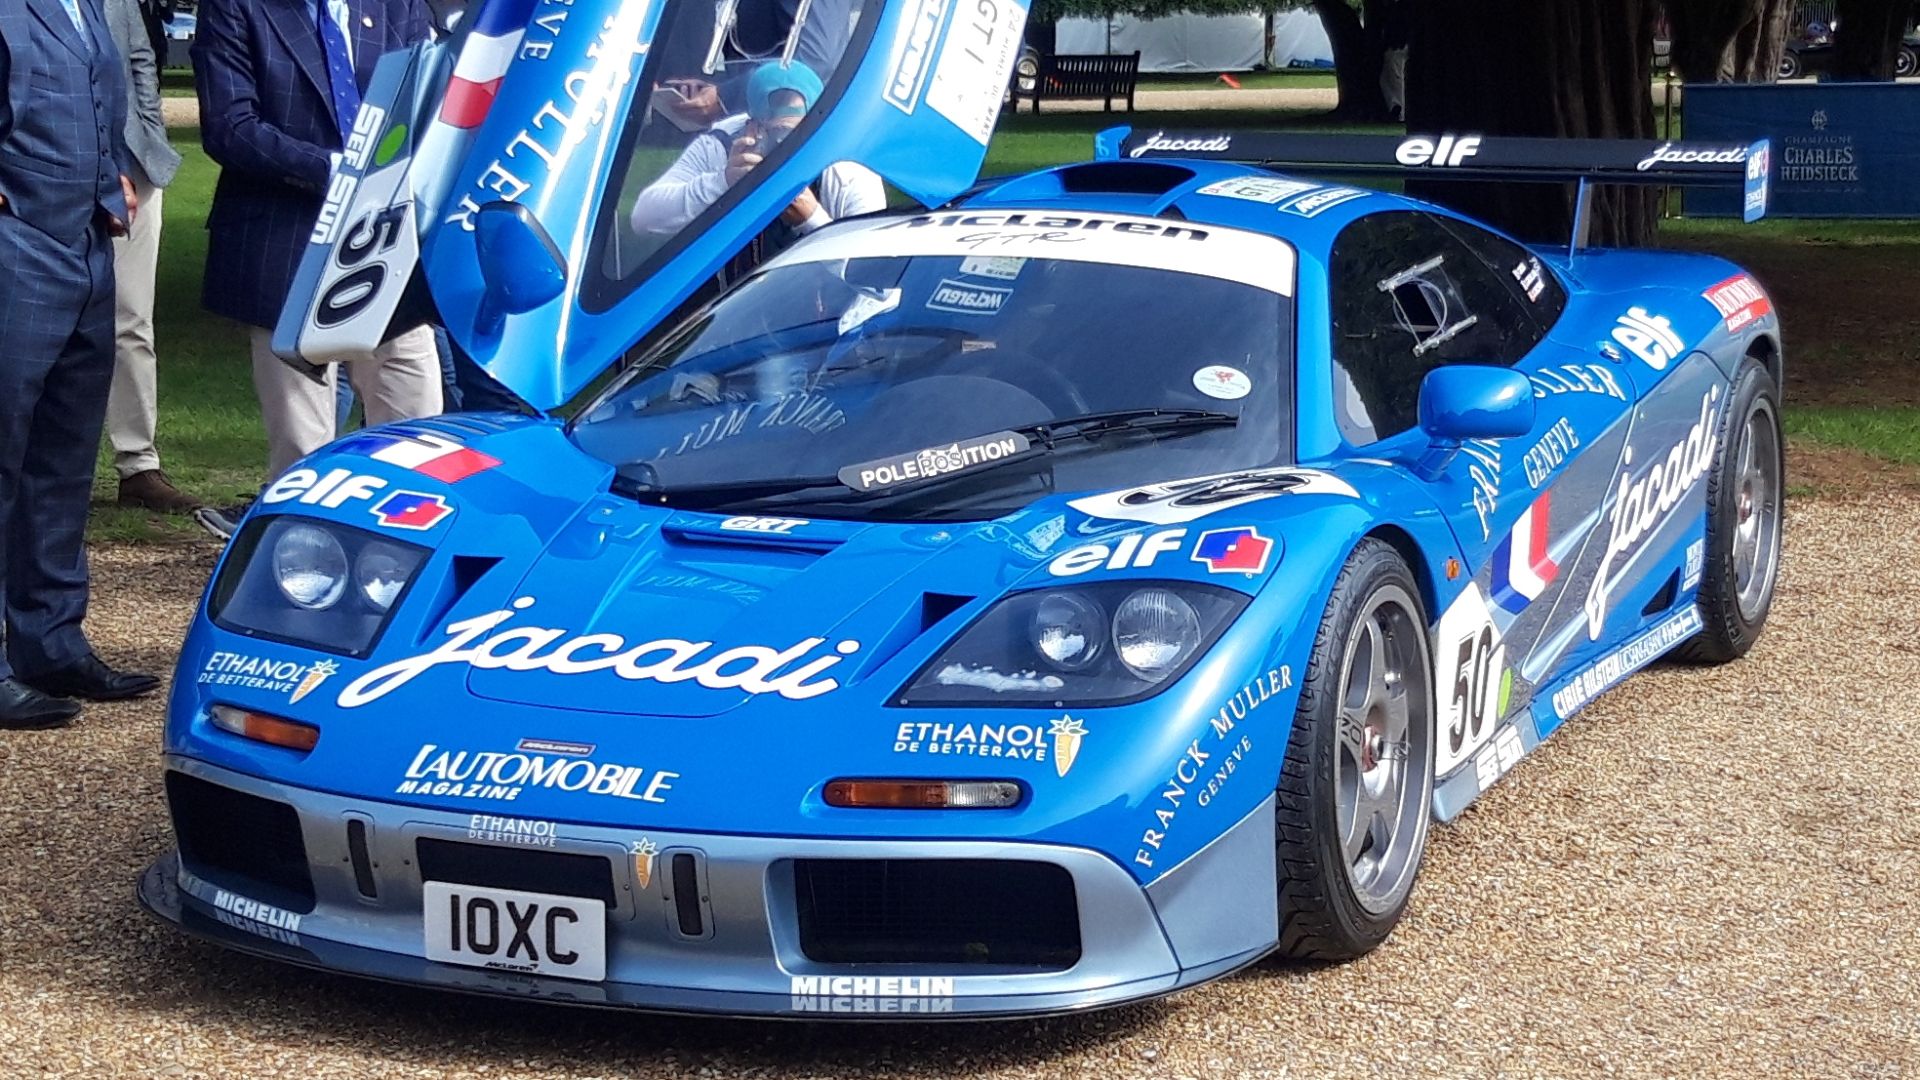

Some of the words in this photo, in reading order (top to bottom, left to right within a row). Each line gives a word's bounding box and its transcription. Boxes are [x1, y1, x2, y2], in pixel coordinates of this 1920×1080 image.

[1129, 130, 1232, 159] jacadi
[1395, 133, 1480, 167] elf
[1636, 142, 1748, 171] jacadi
[1784, 146, 1854, 164] CHARLES
[1780, 166, 1859, 181] HEIDSIECK
[873, 213, 1209, 242] McLaren
[314, 200, 413, 330] 50
[1611, 305, 1686, 371] elf
[1522, 416, 1580, 490] GENEVE
[262, 468, 388, 509] elf
[719, 516, 811, 535] GRT
[1585, 383, 1718, 641] jacadi
[1048, 528, 1188, 577] elf
[205, 651, 307, 683] ETHANOL
[337, 595, 861, 709] jacadi
[198, 672, 216, 683] DE
[217, 674, 295, 693] BETTERAVE
[1449, 620, 1494, 759] 50
[896, 722, 1048, 748] ETHANOL
[893, 741, 920, 753] DE
[928, 743, 1047, 762] BETTERAVE
[1135, 738, 1211, 869] FRANCK
[1210, 664, 1294, 740] MULLER
[1197, 734, 1253, 808] GENEVE
[395, 780, 522, 801] MAGAZINE
[468, 829, 484, 840] DE
[487, 831, 558, 848] BETTERAVE
[470, 814, 558, 838] ETHANOL
[213, 889, 302, 932] MICHELIN
[791, 975, 953, 996] MICHELIN
